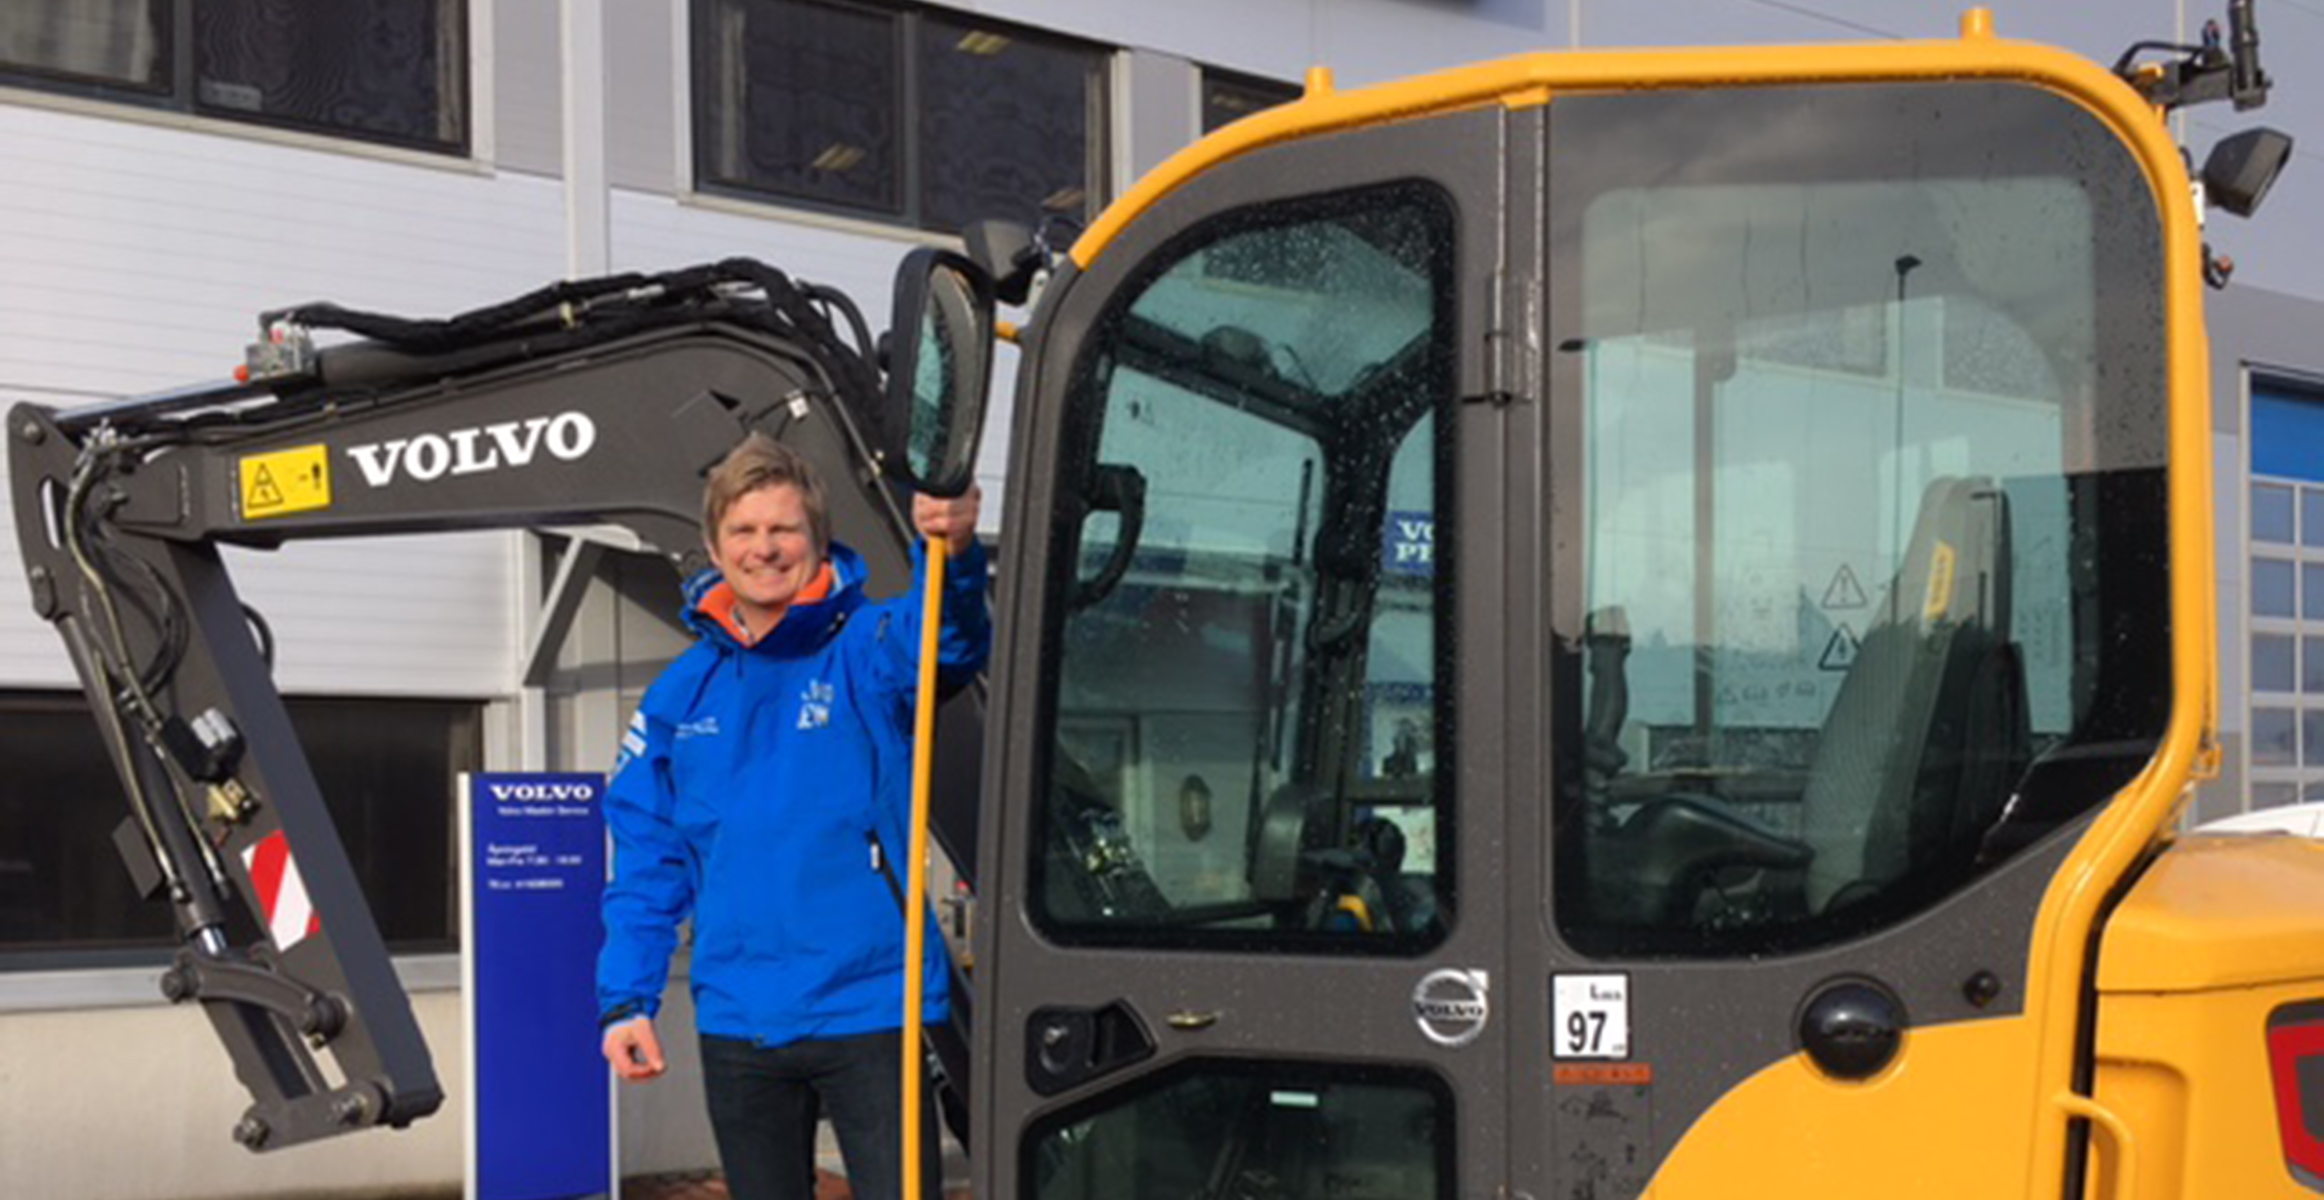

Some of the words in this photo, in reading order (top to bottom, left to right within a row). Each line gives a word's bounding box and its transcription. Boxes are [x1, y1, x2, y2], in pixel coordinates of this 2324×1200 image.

[347, 411, 596, 487] VOLVO
[489, 784, 594, 801] VOLVO
[1413, 1001, 1484, 1018] VOLVO
[1567, 1010, 1608, 1053] 97
